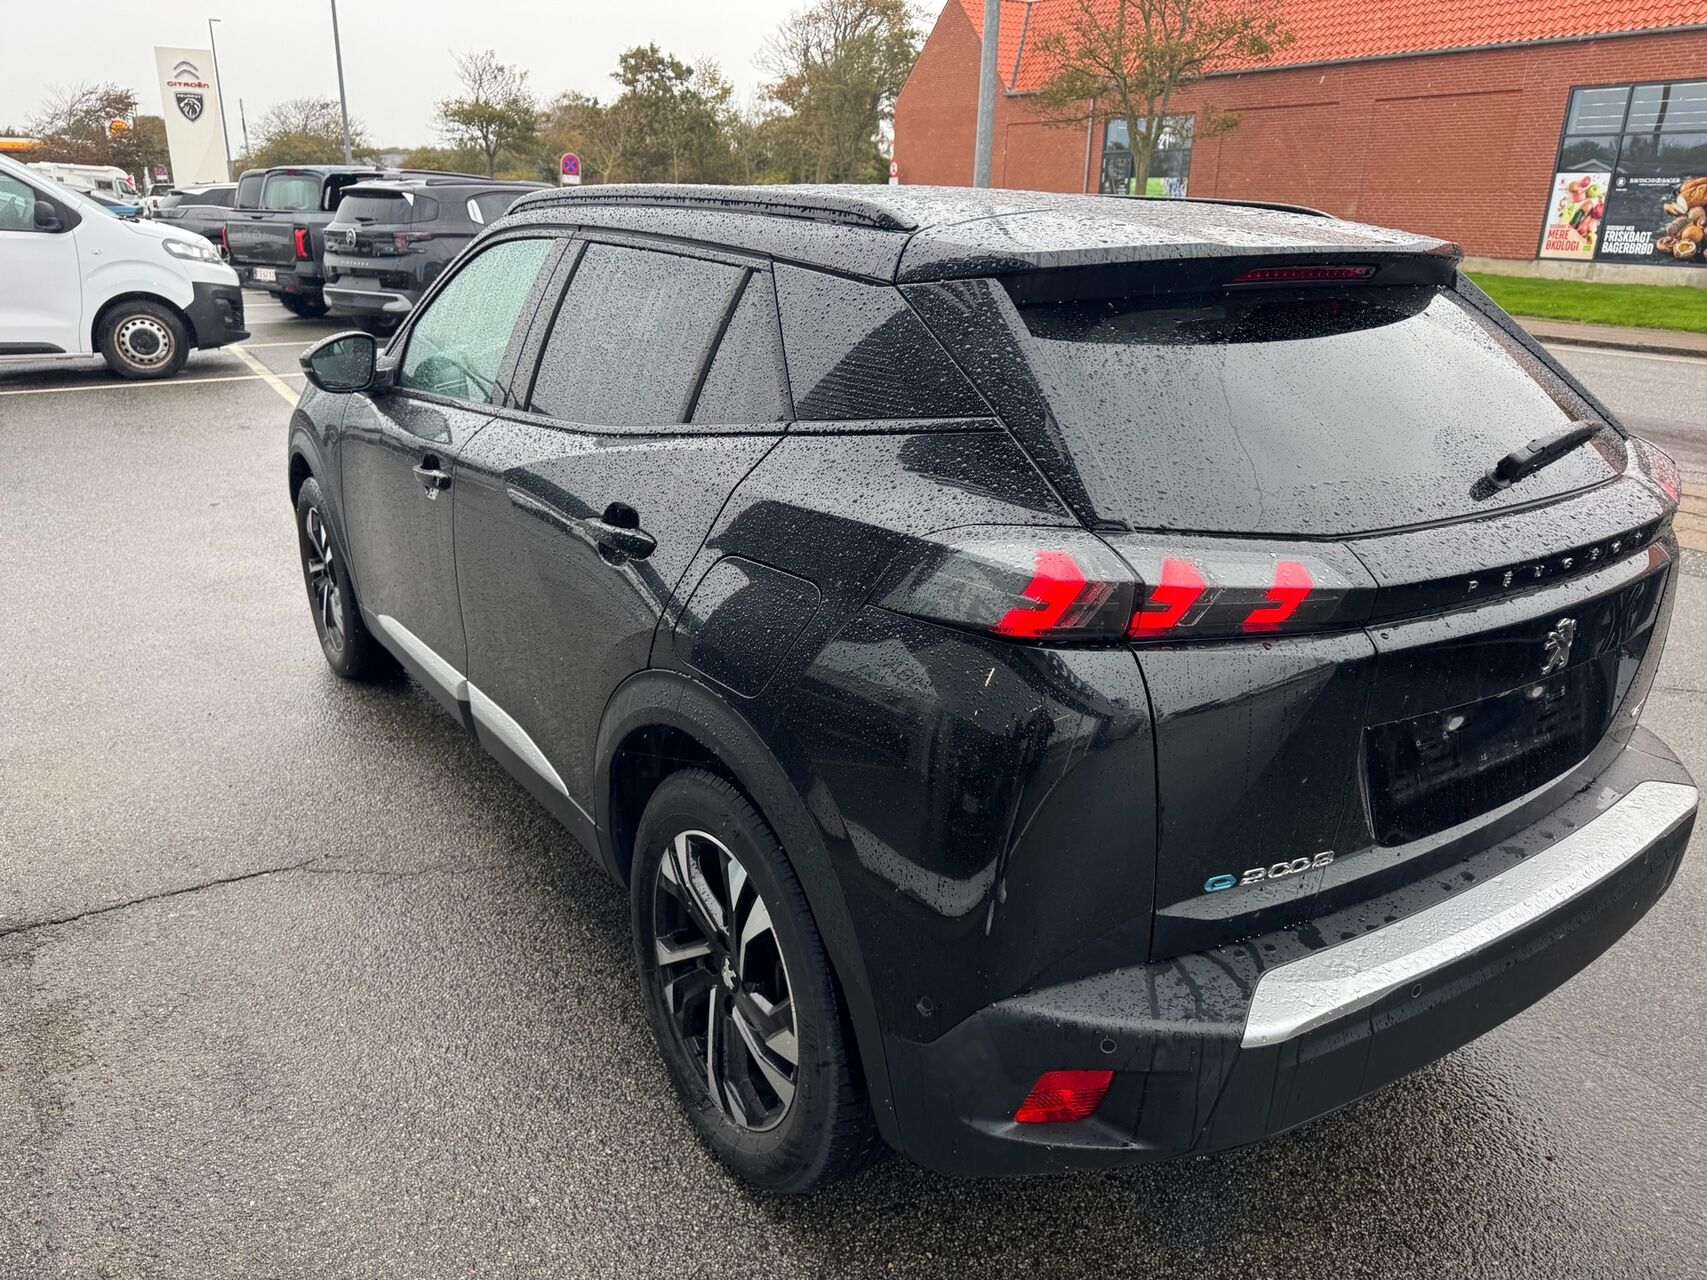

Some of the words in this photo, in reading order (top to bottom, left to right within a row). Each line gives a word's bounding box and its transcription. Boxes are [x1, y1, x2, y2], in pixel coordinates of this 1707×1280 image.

[1547, 230, 1570, 240] MERE
[1603, 231, 1652, 243] FRISKBAGT
[1546, 240, 1579, 252] ØKOLOGI
[1602, 242, 1654, 254] BAGERBRØD
[1467, 530, 1643, 593] PEUGEOT
[1240, 850, 1335, 886] 2008
